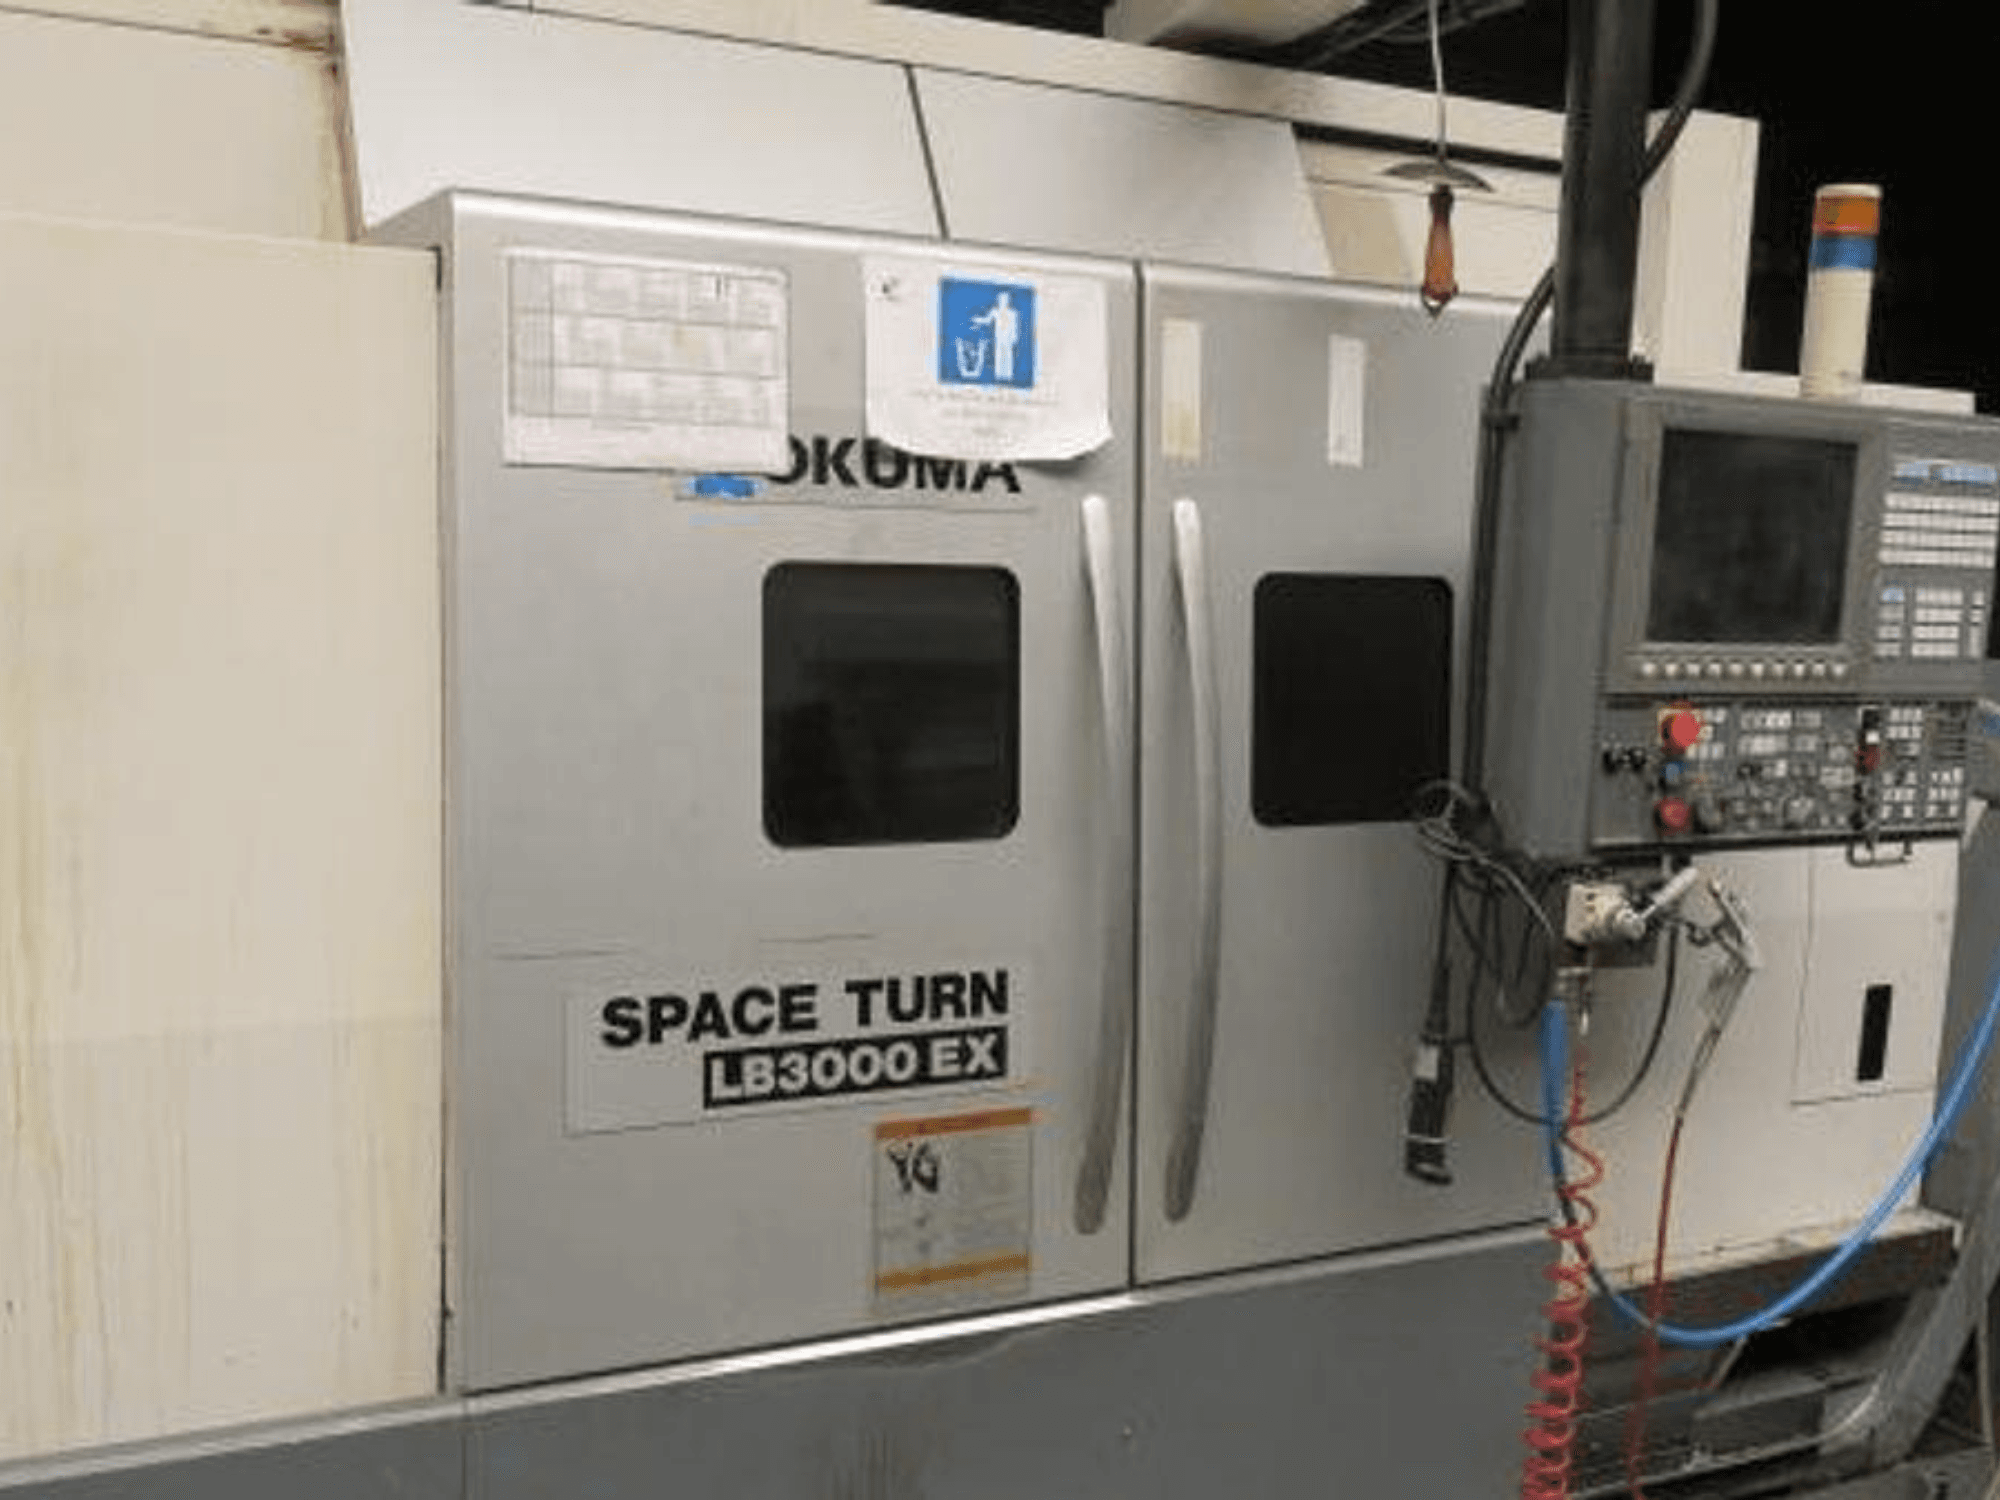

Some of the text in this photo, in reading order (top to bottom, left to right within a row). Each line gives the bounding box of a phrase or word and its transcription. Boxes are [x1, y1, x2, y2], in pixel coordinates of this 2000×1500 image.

[602, 970, 1008, 1048] SPACE TURN
[710, 1033, 998, 1098] LB3000 EX
